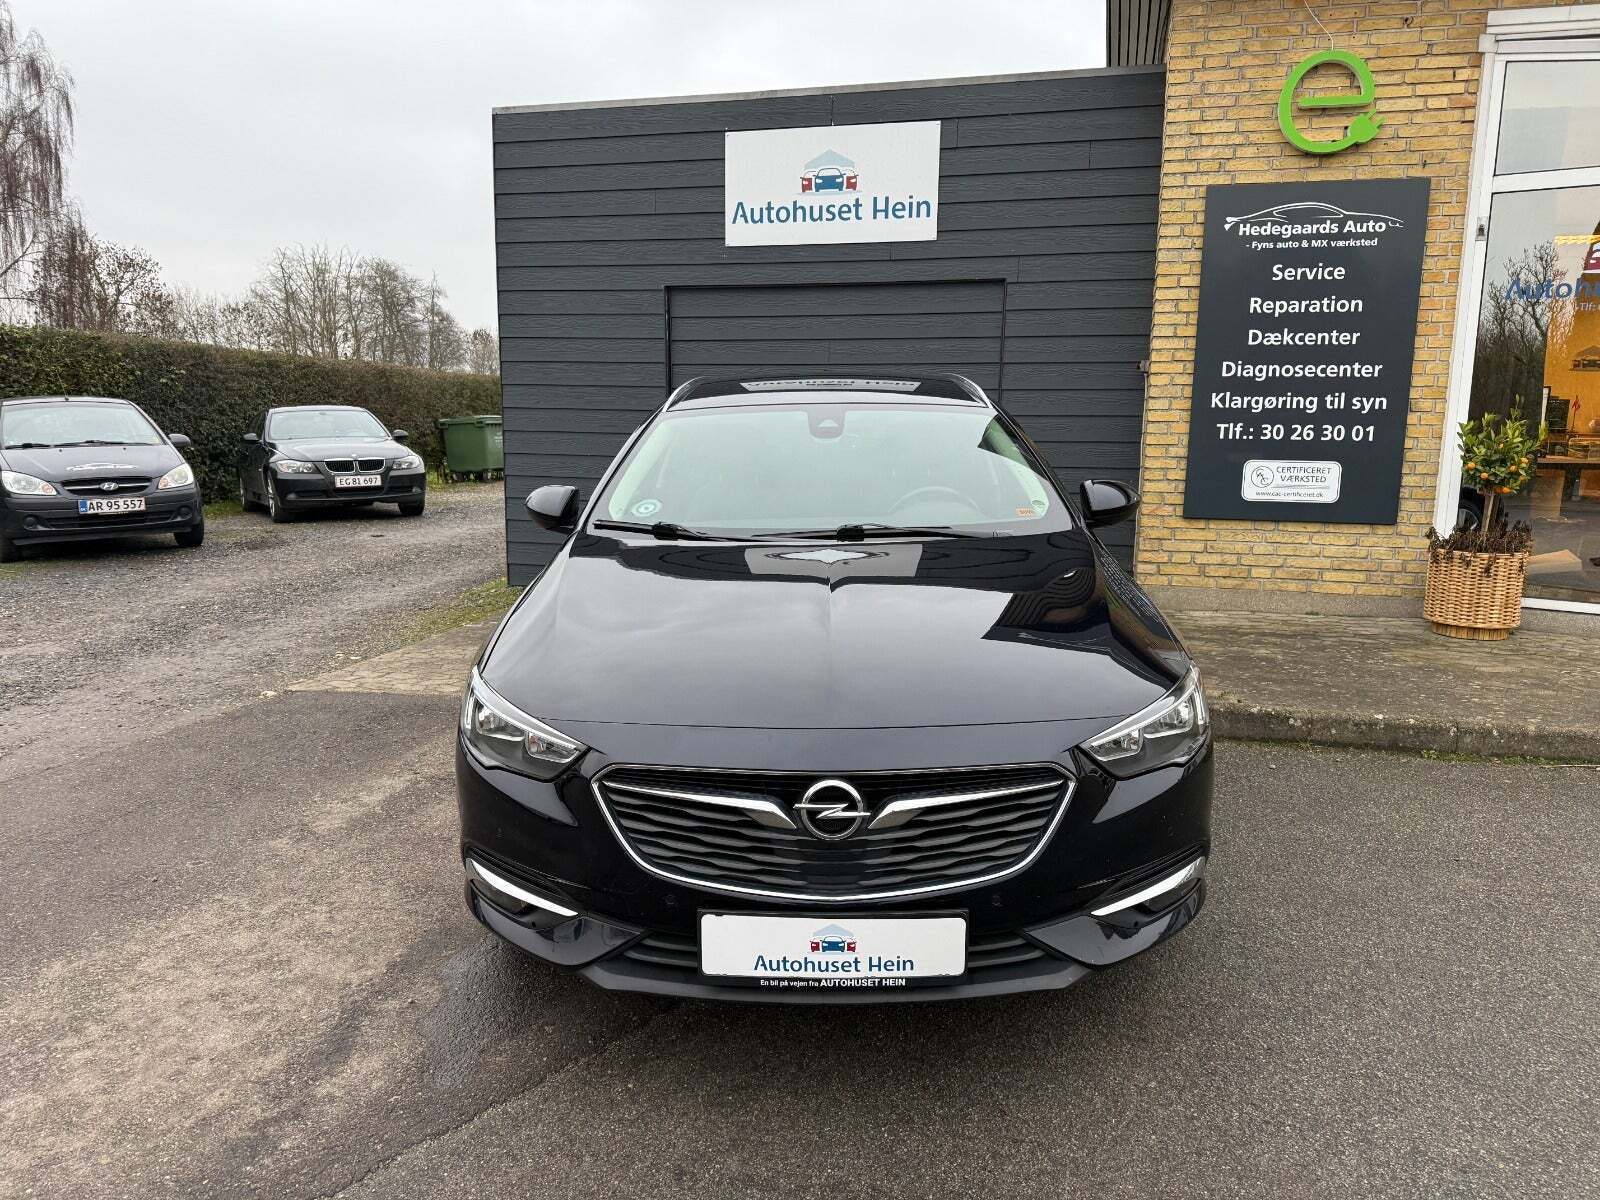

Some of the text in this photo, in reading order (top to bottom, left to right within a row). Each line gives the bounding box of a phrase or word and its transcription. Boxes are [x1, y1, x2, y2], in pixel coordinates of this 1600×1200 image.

[731, 195, 931, 225] Autohuset Hein
[1238, 219, 1387, 239] Hedegaards Auto
[1251, 241, 1274, 251] Fyns
[1276, 240, 1299, 249] auto
[1301, 239, 1309, 248] &
[1311, 239, 1328, 248] MX
[1330, 237, 1378, 248] værksted
[1272, 262, 1346, 281] Service
[1249, 295, 1363, 317] Reparation
[1247, 327, 1361, 346] Dækcenter
[1221, 360, 1383, 382] Diagnosecenter
[1211, 391, 1387, 414] Klargøring til syn
[1217, 422, 1375, 442] Tlf.: 30 26 30 01
[1276, 466, 1332, 475] CERTIFICERET
[1280, 475, 1327, 483] VÆRKSTED
[340, 477, 378, 486] EG 81 697
[89, 501, 104, 512] AR
[106, 500, 120, 511] 95
[123, 499, 143, 510] 557
[753, 955, 914, 973] Autohuset Hein
[780, 979, 789, 987] på
[789, 980, 808, 988] vejen
[820, 978, 880, 987] AUTOHUSET
[882, 978, 906, 986] HEIN
